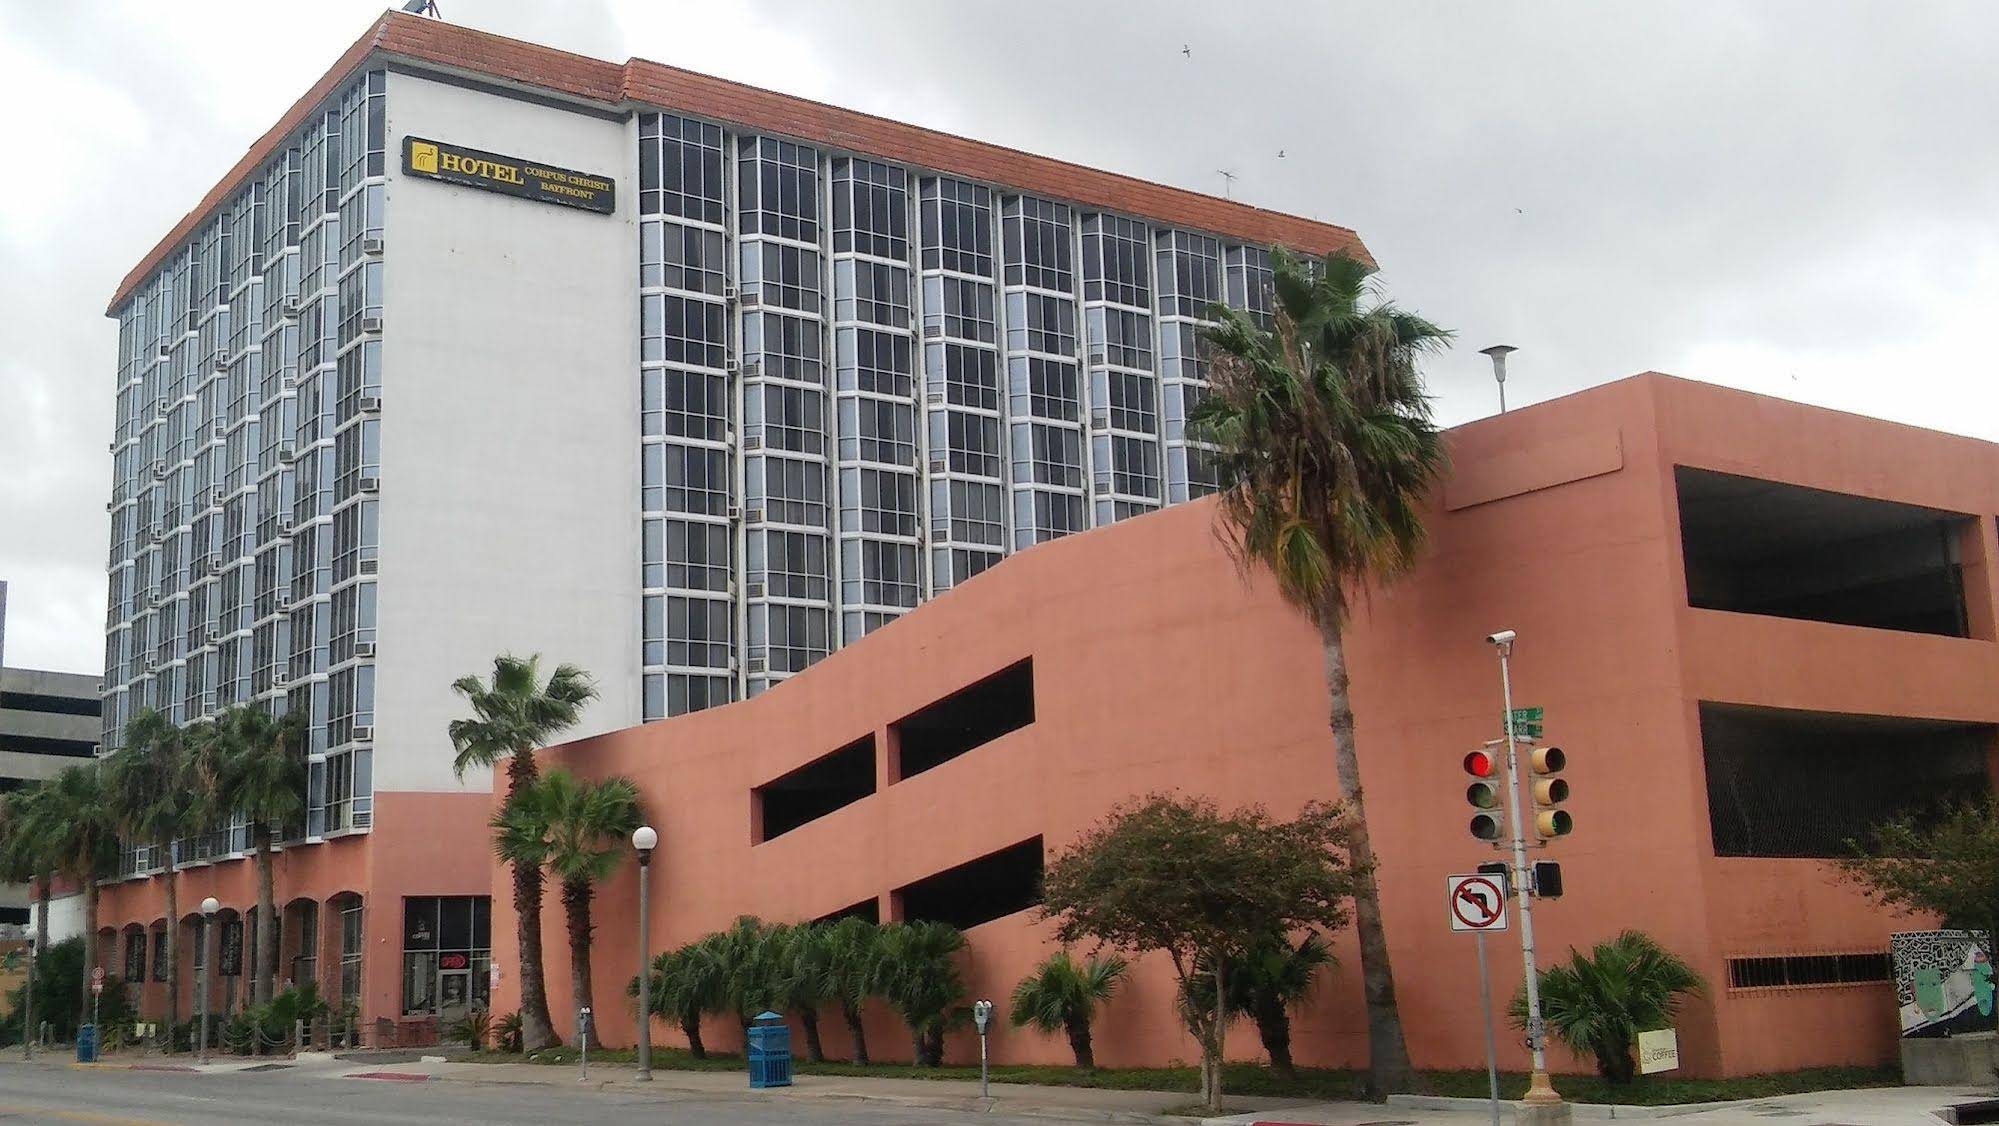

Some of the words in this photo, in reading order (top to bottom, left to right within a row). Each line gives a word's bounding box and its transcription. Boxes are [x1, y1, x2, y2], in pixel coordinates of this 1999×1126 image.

[441, 152, 525, 185] HOTEL
[525, 166, 567, 182] CORPUS
[568, 176, 610, 192] CHRISTI
[541, 182, 594, 200] BAYFRONT
